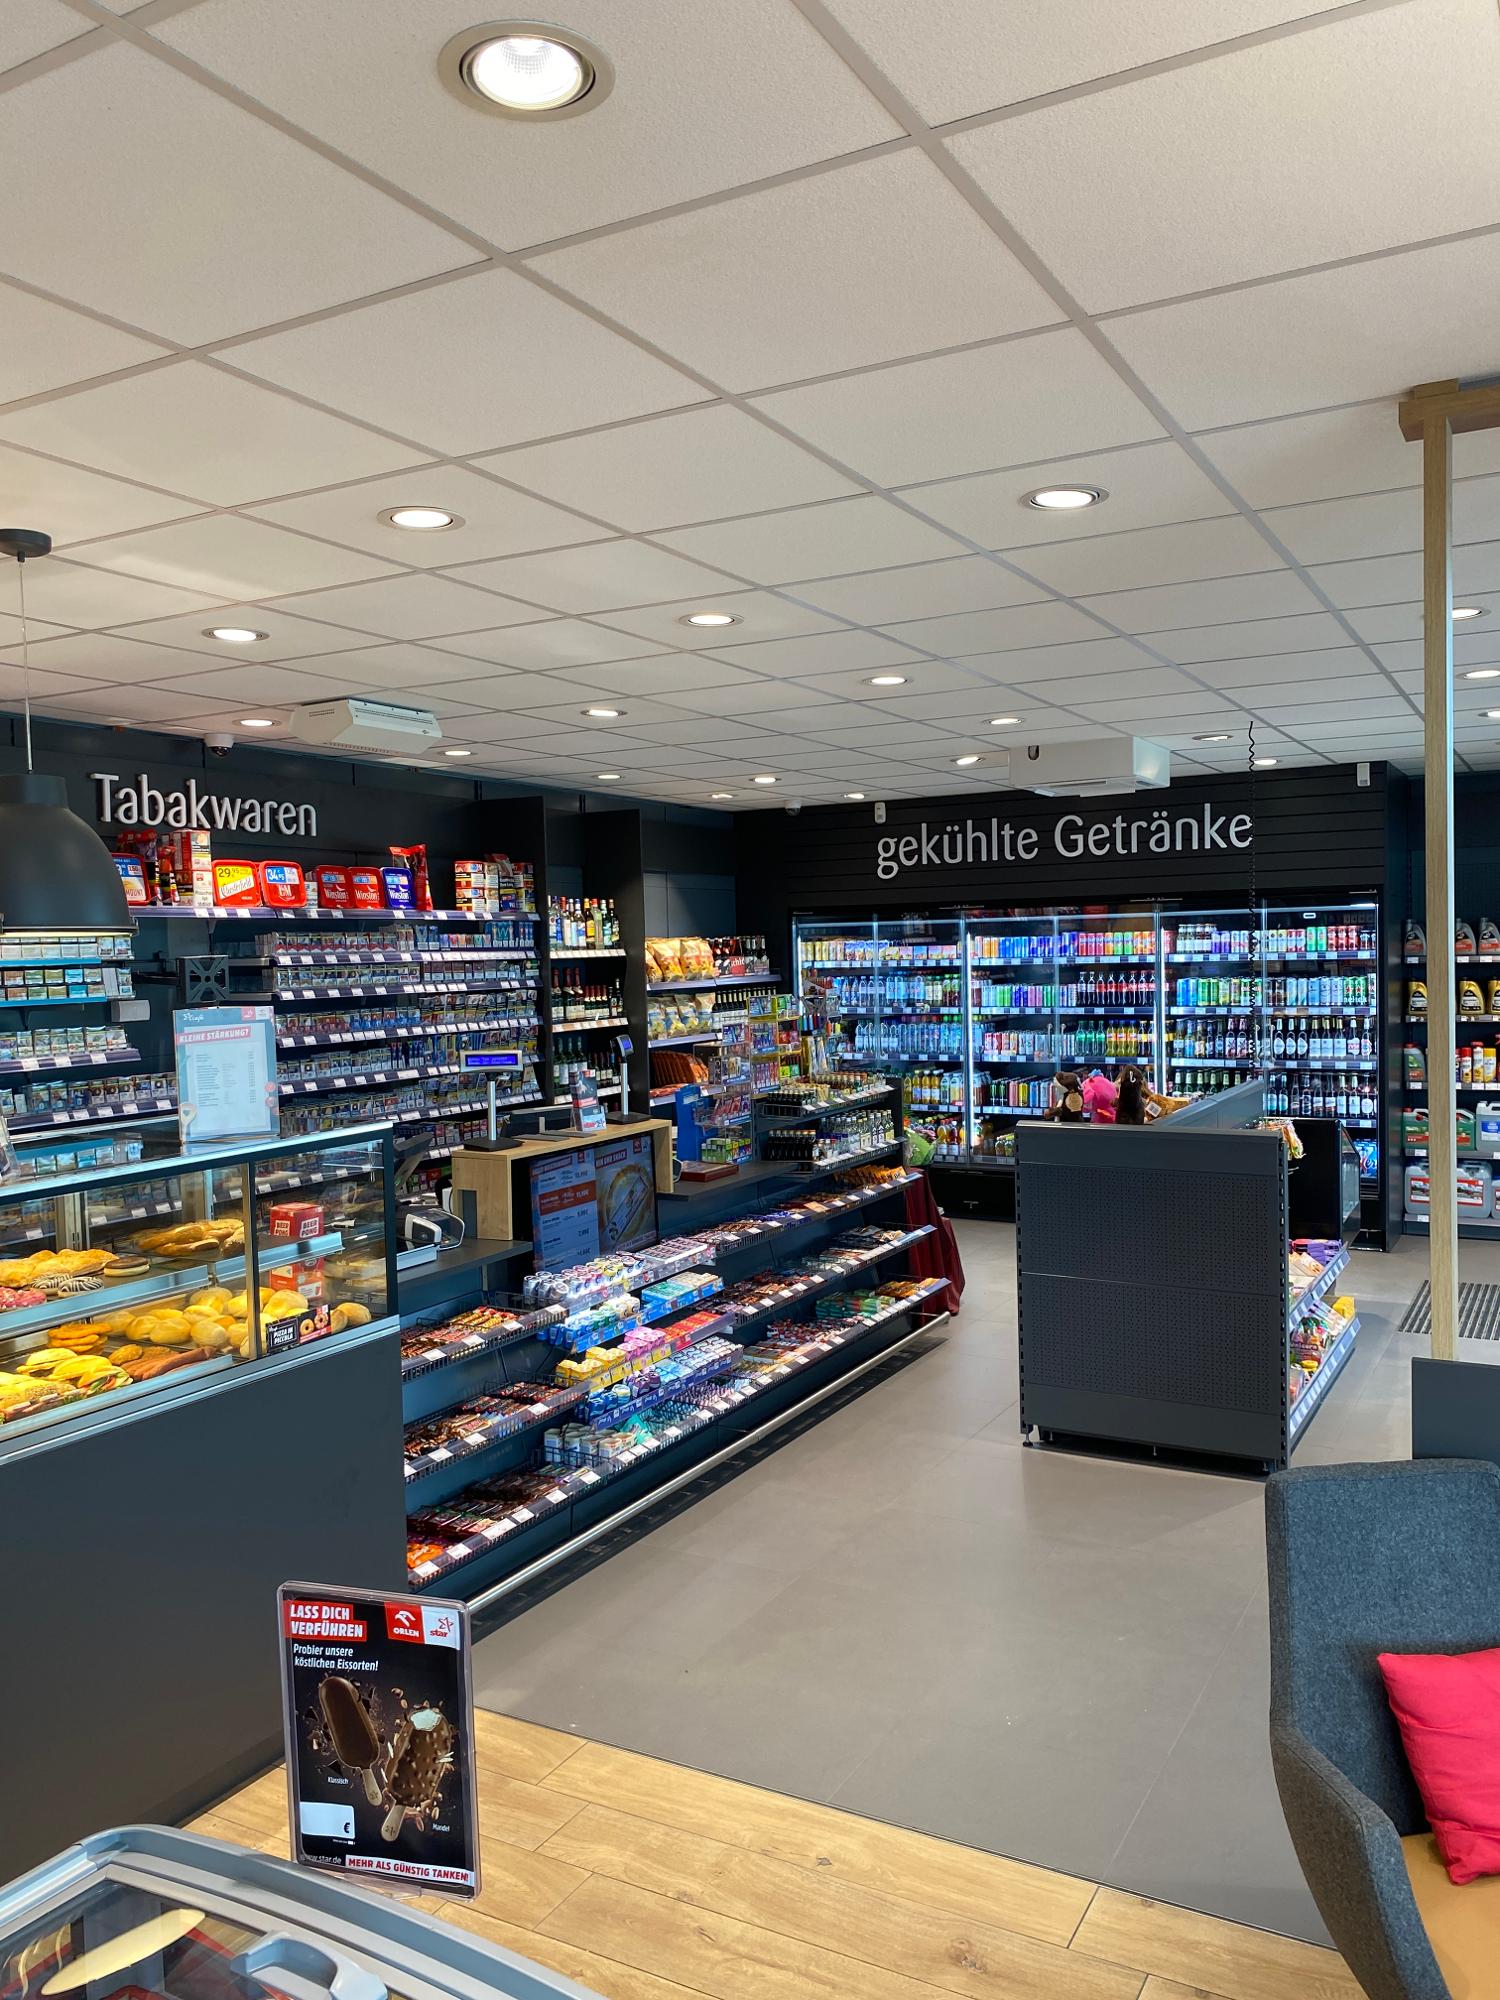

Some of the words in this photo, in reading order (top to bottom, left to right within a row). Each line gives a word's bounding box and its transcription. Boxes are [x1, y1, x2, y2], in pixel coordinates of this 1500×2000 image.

[90, 773, 317, 837] Tabakwaren
[876, 817, 1039, 880] gekühlte
[1054, 802, 1253, 857] Getränke
[217, 867, 231, 878] 29
[267, 869, 279, 881] 34
[323, 888, 347, 900] Winston
[355, 889, 378, 900] Winston
[388, 888, 409, 900] Winston
[180, 1032, 206, 1043] KLEINE
[206, 1027, 249, 1041] STÄRKUNG?
[302, 1219, 318, 1229] BEER
[301, 1227, 318, 1237] PONG
[290, 1604, 319, 1619] LASS
[321, 1606, 350, 1621] DICH
[291, 1620, 363, 1638] VERFÜHREN
[393, 1627, 420, 1638] ORLEN
[429, 1629, 449, 1638] star
[293, 1643, 324, 1656] Probier
[325, 1646, 354, 1657] unsere
[294, 1655, 335, 1669] köstlichen
[337, 1659, 379, 1671] Eissorten!
[327, 1776, 349, 1785] Klassisch
[343, 1822, 351, 1834] €
[432, 1822, 450, 1832] Mandel
[348, 1858, 374, 1868] MEHR
[375, 1860, 391, 1870] ALS
[393, 1861, 430, 1877] GÜNSTIG
[432, 1868, 469, 1882] TANKEN!
